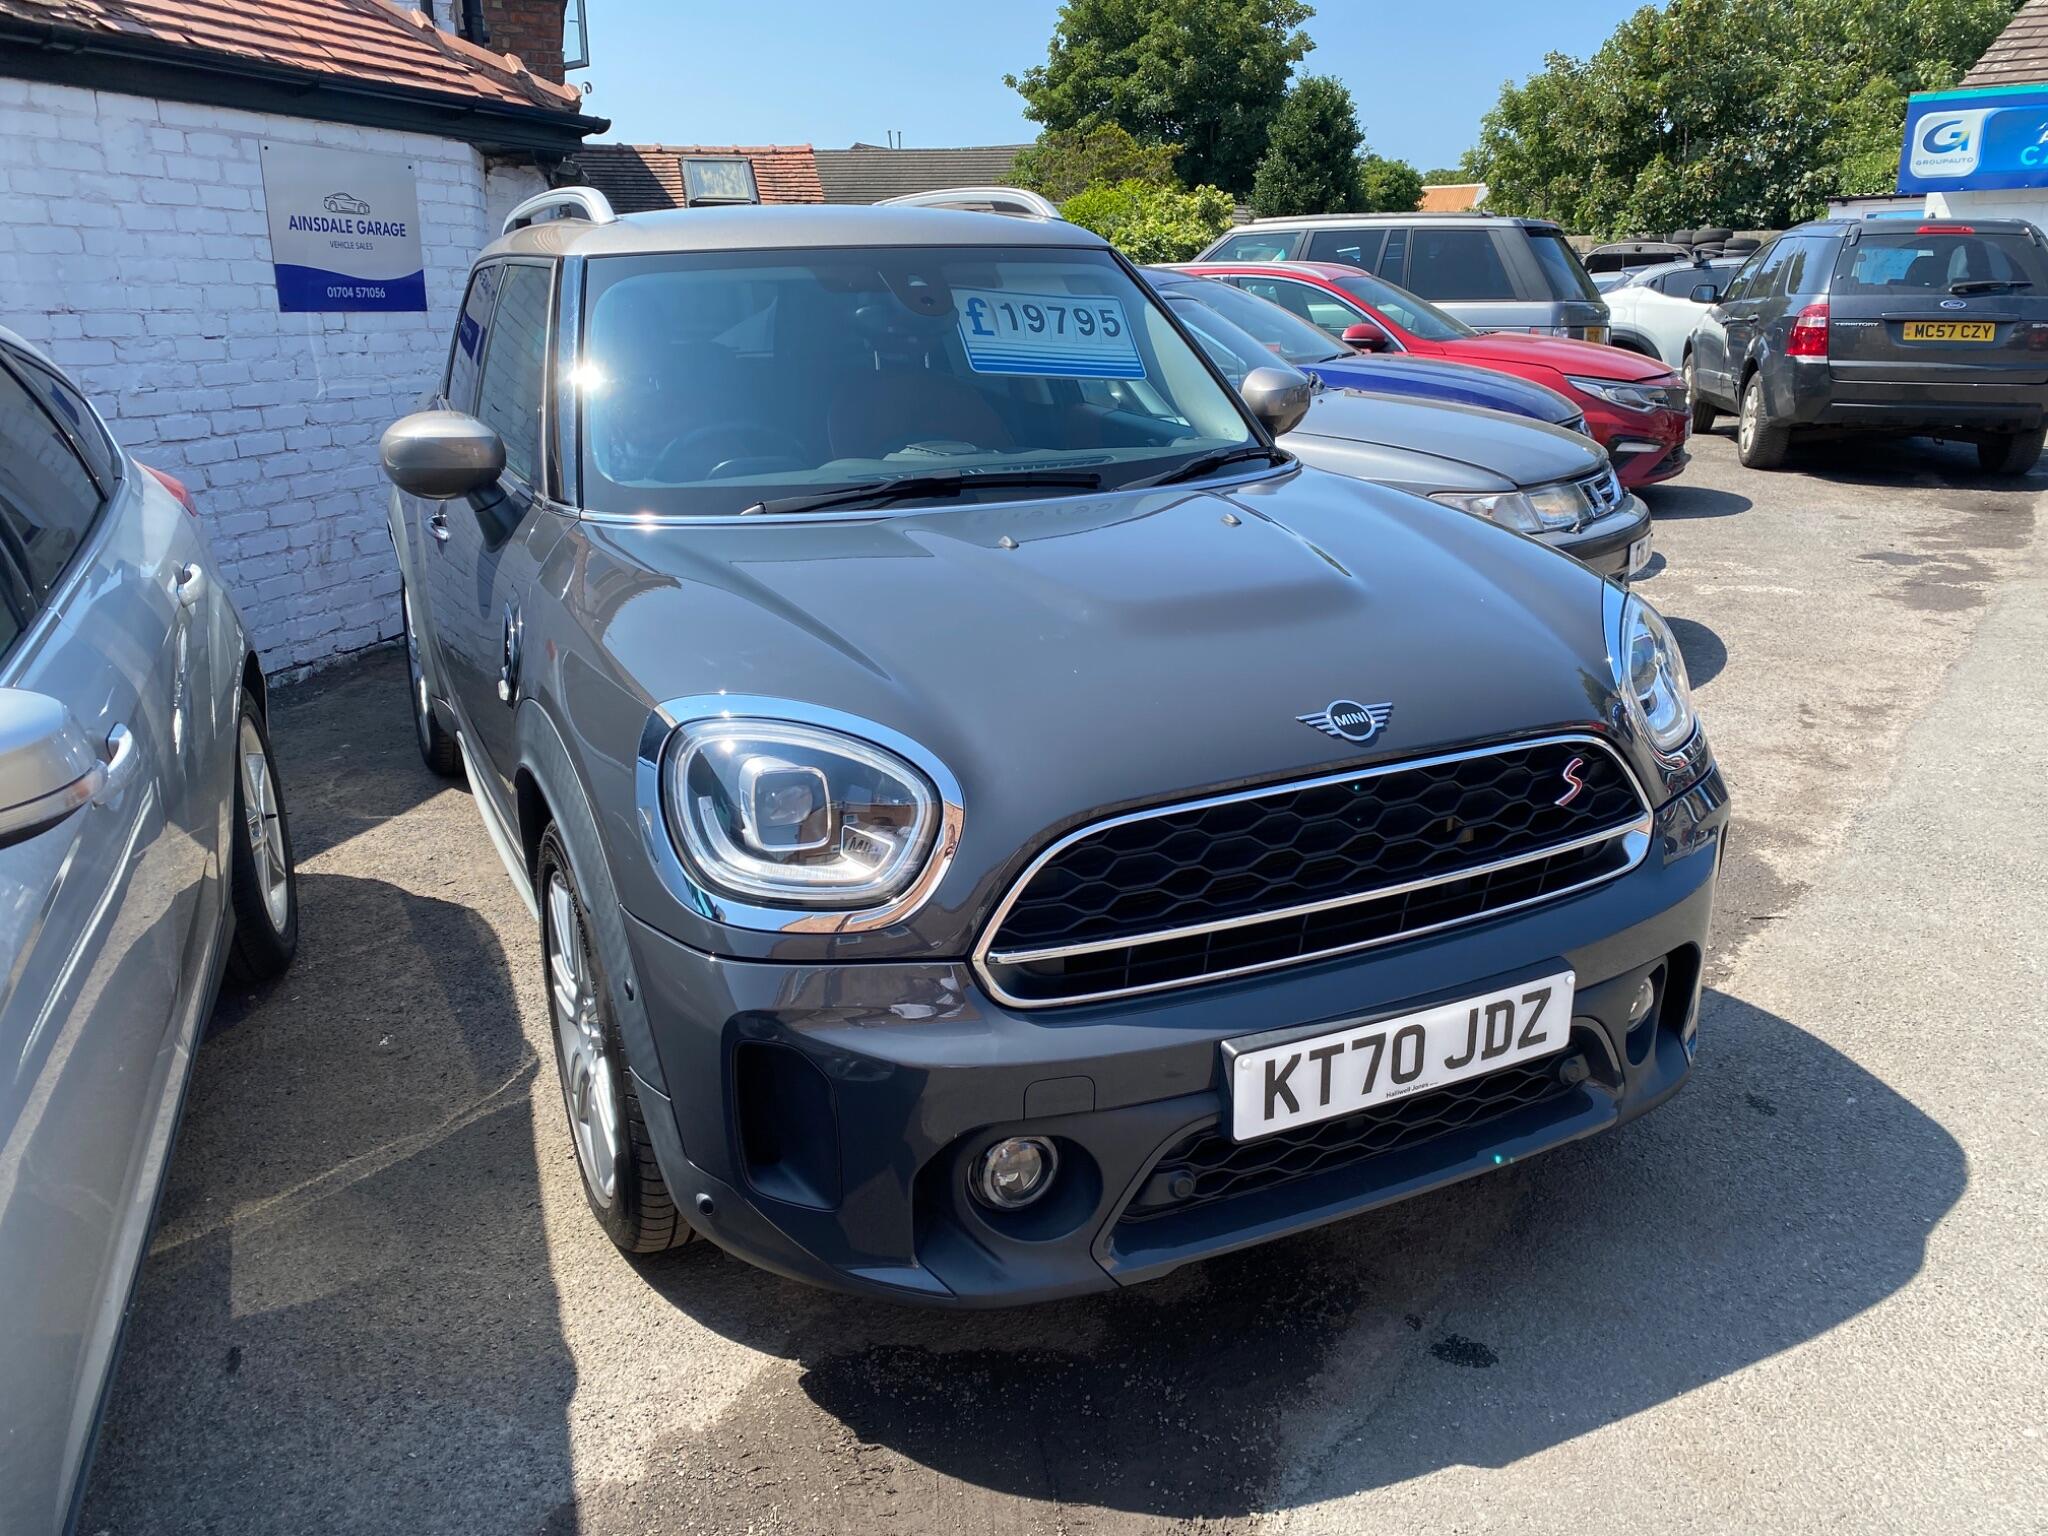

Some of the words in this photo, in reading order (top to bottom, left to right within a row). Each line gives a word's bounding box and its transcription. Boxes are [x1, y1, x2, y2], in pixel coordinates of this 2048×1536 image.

[1916, 156, 1974, 166] GROUPAUTO
[289, 215, 353, 234] AINSDALE
[356, 220, 407, 237] GARAGE
[329, 241, 354, 249] VEHICLE
[355, 242, 373, 250] SALES
[326, 287, 354, 298] 01704
[355, 287, 386, 298] 571056
[1914, 324, 1957, 338] MC57
[1960, 324, 1992, 339] CZY
[1333, 711, 1369, 726] MINI
[1554, 758, 1583, 806] S
[1264, 1024, 1426, 1121] KT70
[1444, 987, 1552, 1070] JDZ
